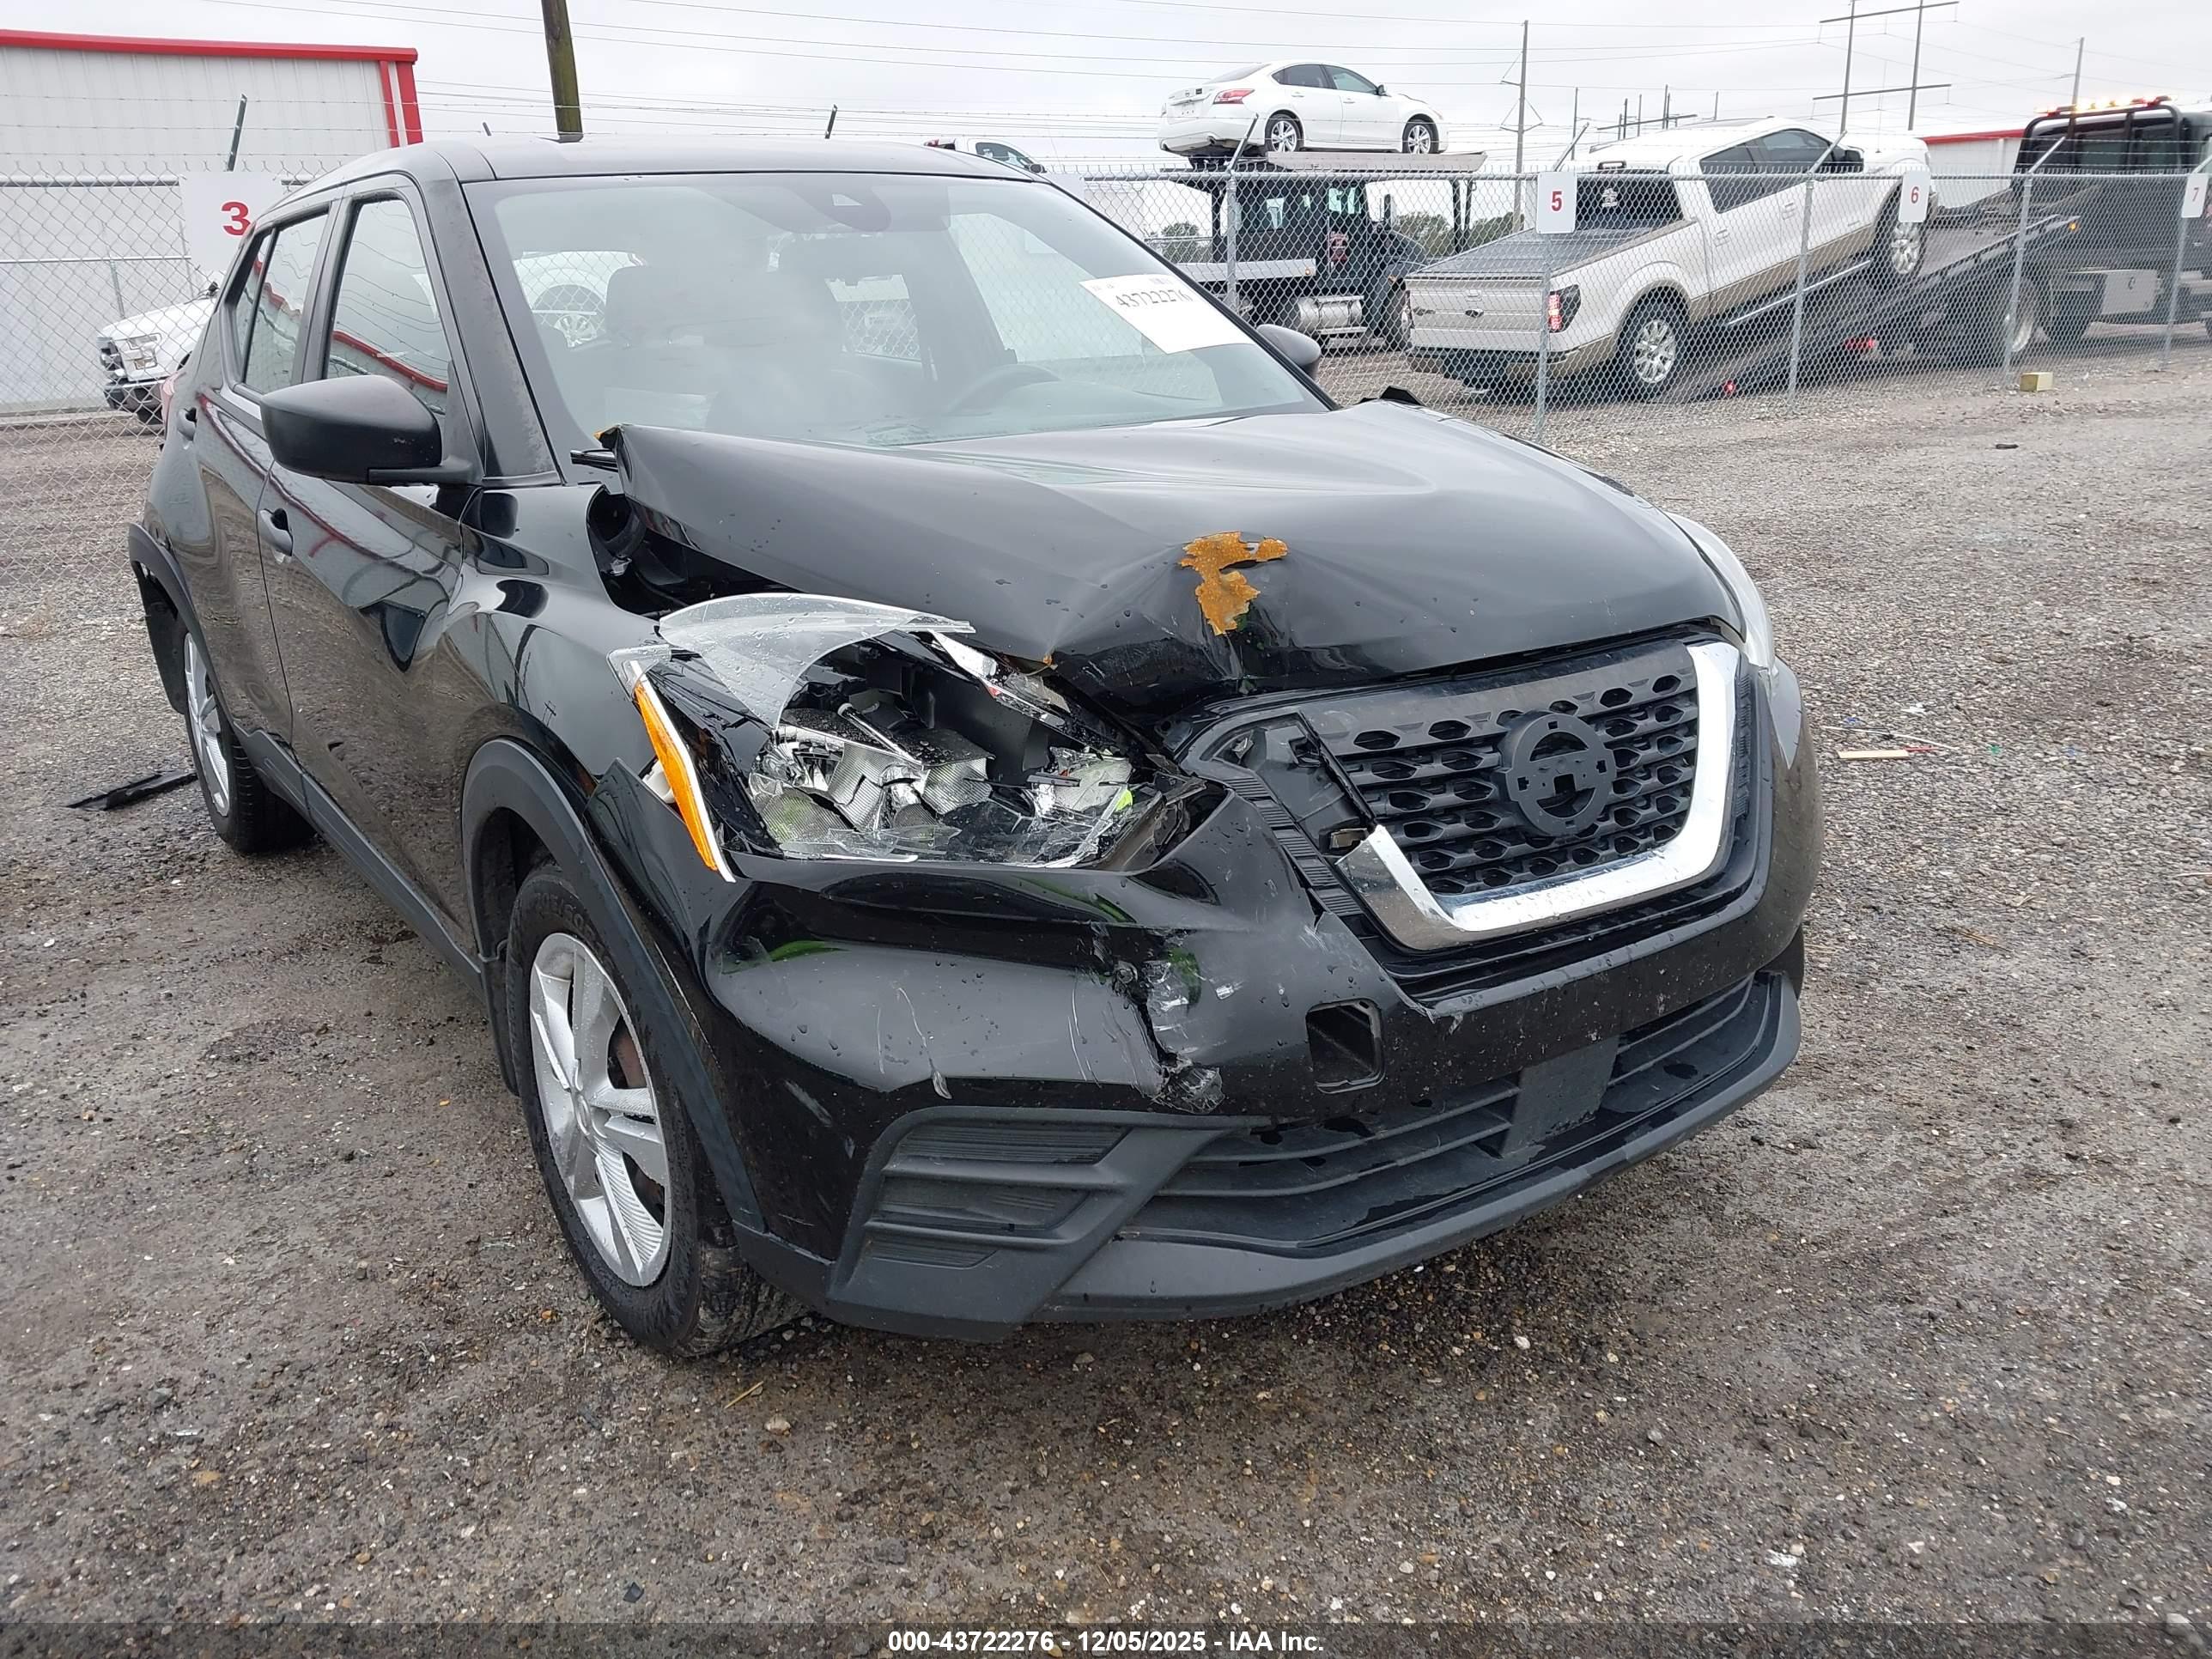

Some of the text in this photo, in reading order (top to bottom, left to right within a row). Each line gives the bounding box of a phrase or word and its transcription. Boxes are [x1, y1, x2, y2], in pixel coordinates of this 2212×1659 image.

[1552, 191, 1562, 211] 5
[1911, 186, 1919, 204] 6
[2192, 186, 2199, 202] 7
[222, 202, 251, 235] 3
[1115, 289, 1193, 308] 43722276
